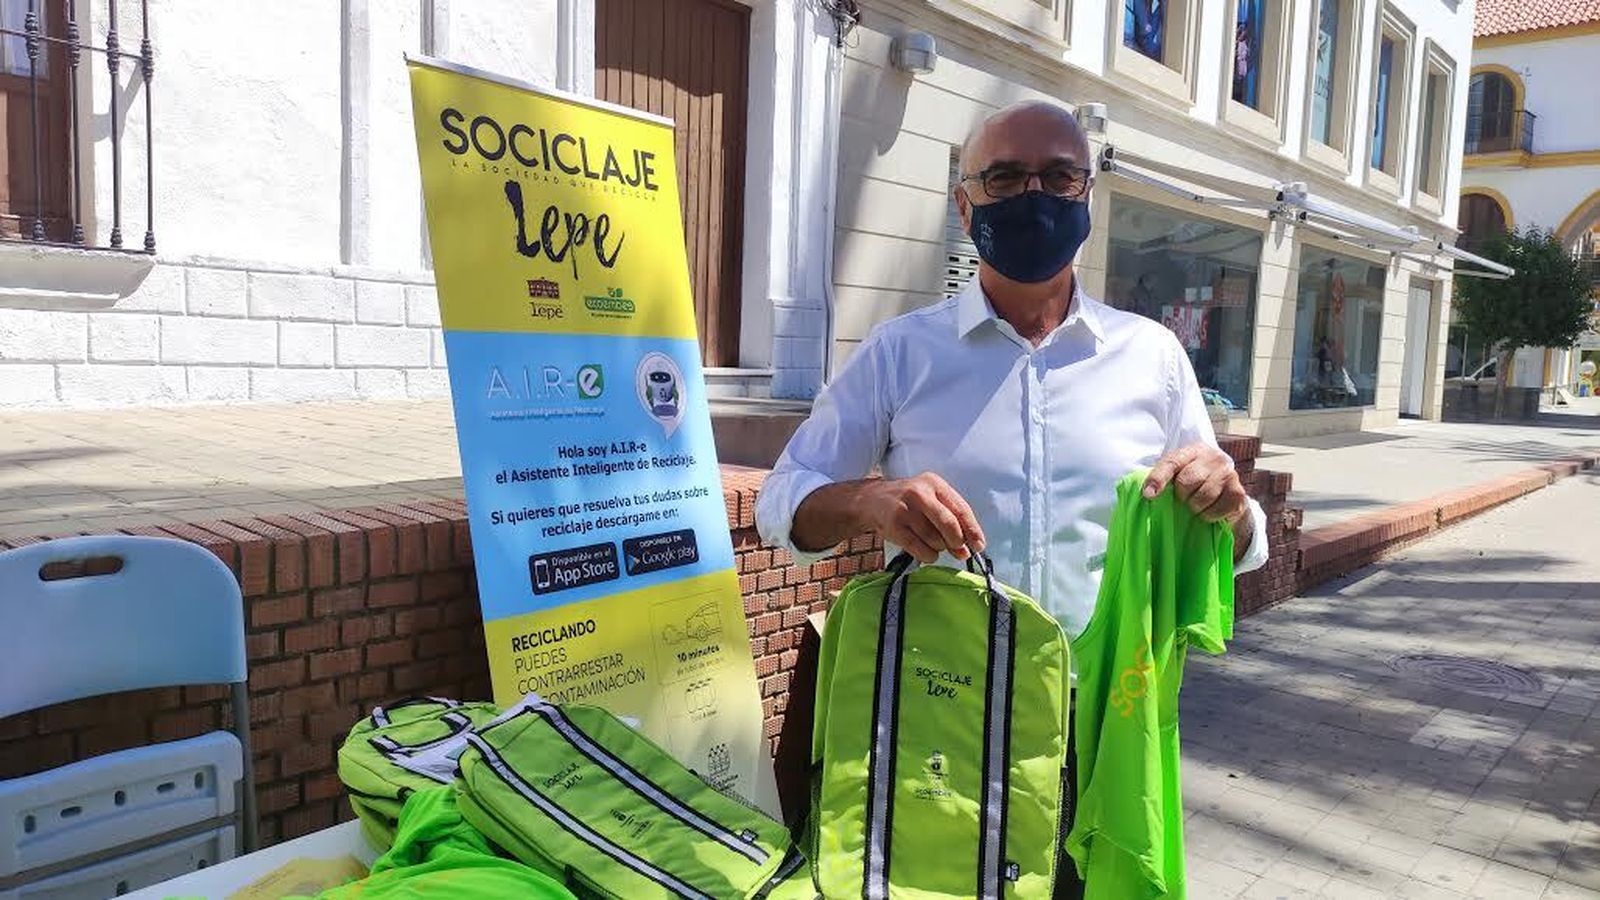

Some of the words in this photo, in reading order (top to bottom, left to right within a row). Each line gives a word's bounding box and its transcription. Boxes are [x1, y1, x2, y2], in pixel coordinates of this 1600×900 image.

[440, 107, 659, 192] SOCICLAJE
[558, 445, 585, 459] Hola
[587, 446, 607, 460] soy
[610, 441, 647, 456] A.I.R-e
[495, 472, 508, 485] el
[510, 465, 570, 483] Asistente
[572, 459, 635, 479] Inteligente
[637, 458, 650, 471] de
[490, 510, 505, 526] Si
[507, 506, 555, 527] quieres
[557, 503, 581, 520] que
[583, 495, 632, 513] resuelva
[634, 494, 649, 507] tus
[651, 489, 682, 505] dudas
[684, 485, 709, 501] sobre
[541, 518, 593, 539] reciclaje
[595, 510, 661, 530] descárgame
[662, 508, 679, 521] en:
[551, 548, 593, 567] Disponible
[593, 551, 604, 559] en
[642, 550, 677, 567] Google
[677, 546, 696, 561] play
[554, 565, 583, 586] App
[583, 560, 616, 579] Store
[511, 619, 597, 653] RECICLANDO
[514, 648, 568, 674] PUEDES
[676, 651, 688, 664] 10
[517, 653, 624, 696] CONTRARRESTAR
[915, 666, 973, 687] SOCICLAJE
